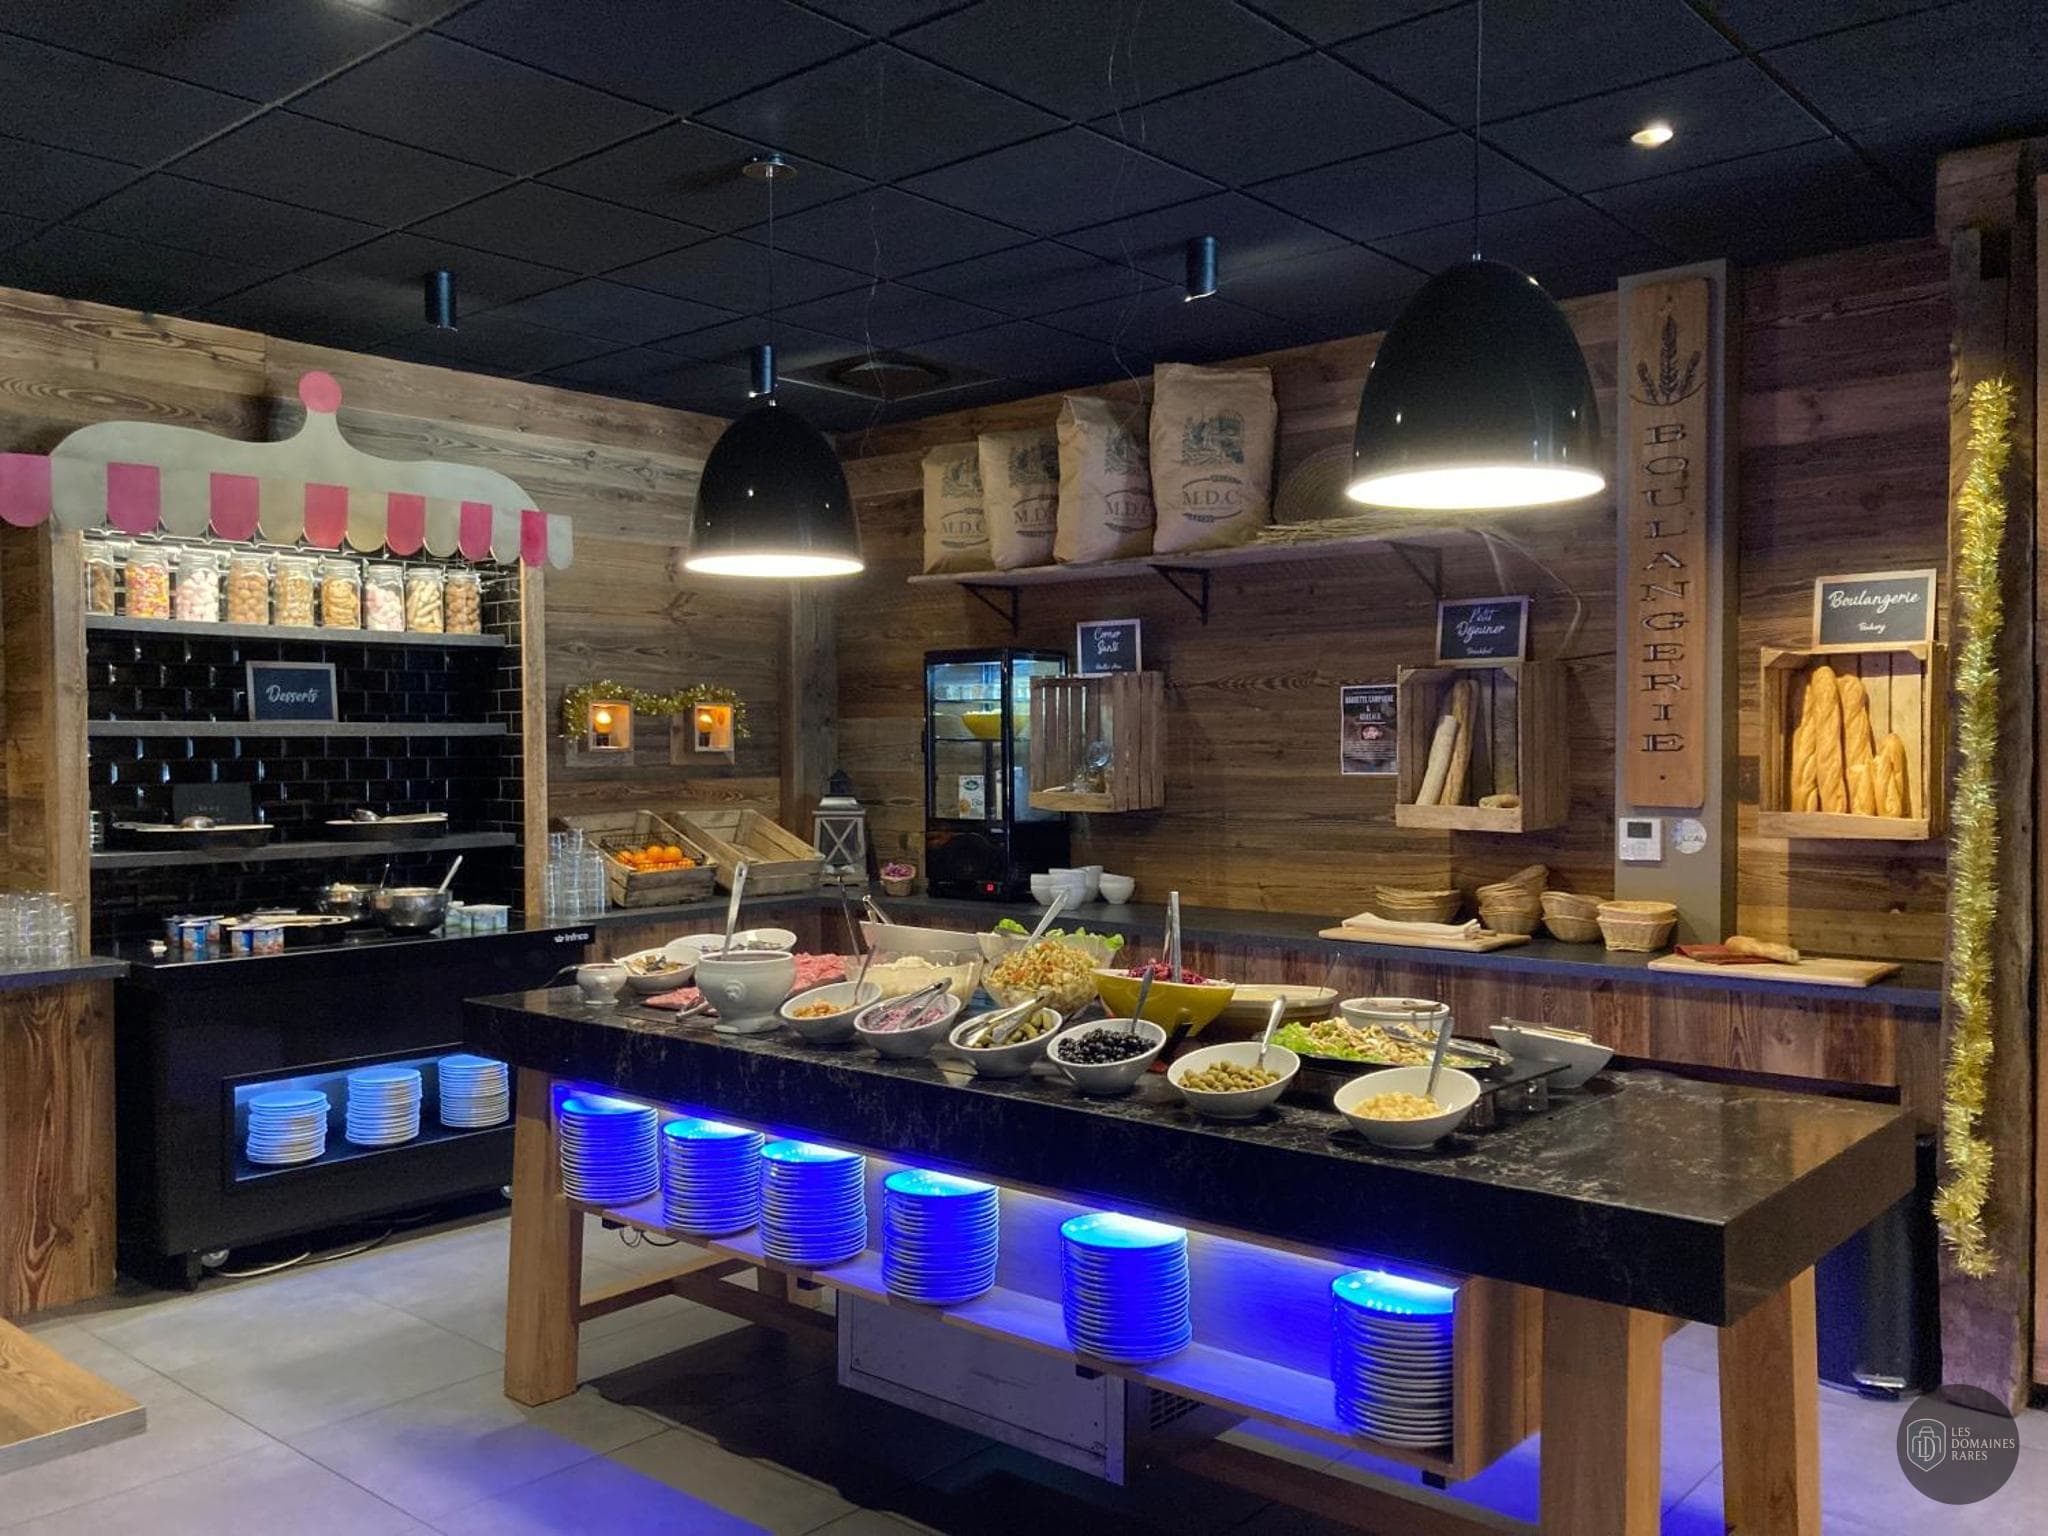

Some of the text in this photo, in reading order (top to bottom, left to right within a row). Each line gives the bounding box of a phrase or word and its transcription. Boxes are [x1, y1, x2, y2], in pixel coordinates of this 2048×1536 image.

[1641, 424, 1689, 753] BOULANGERIE
[1829, 589, 1921, 614] Boulangerie
[265, 685, 319, 703] Desserts
